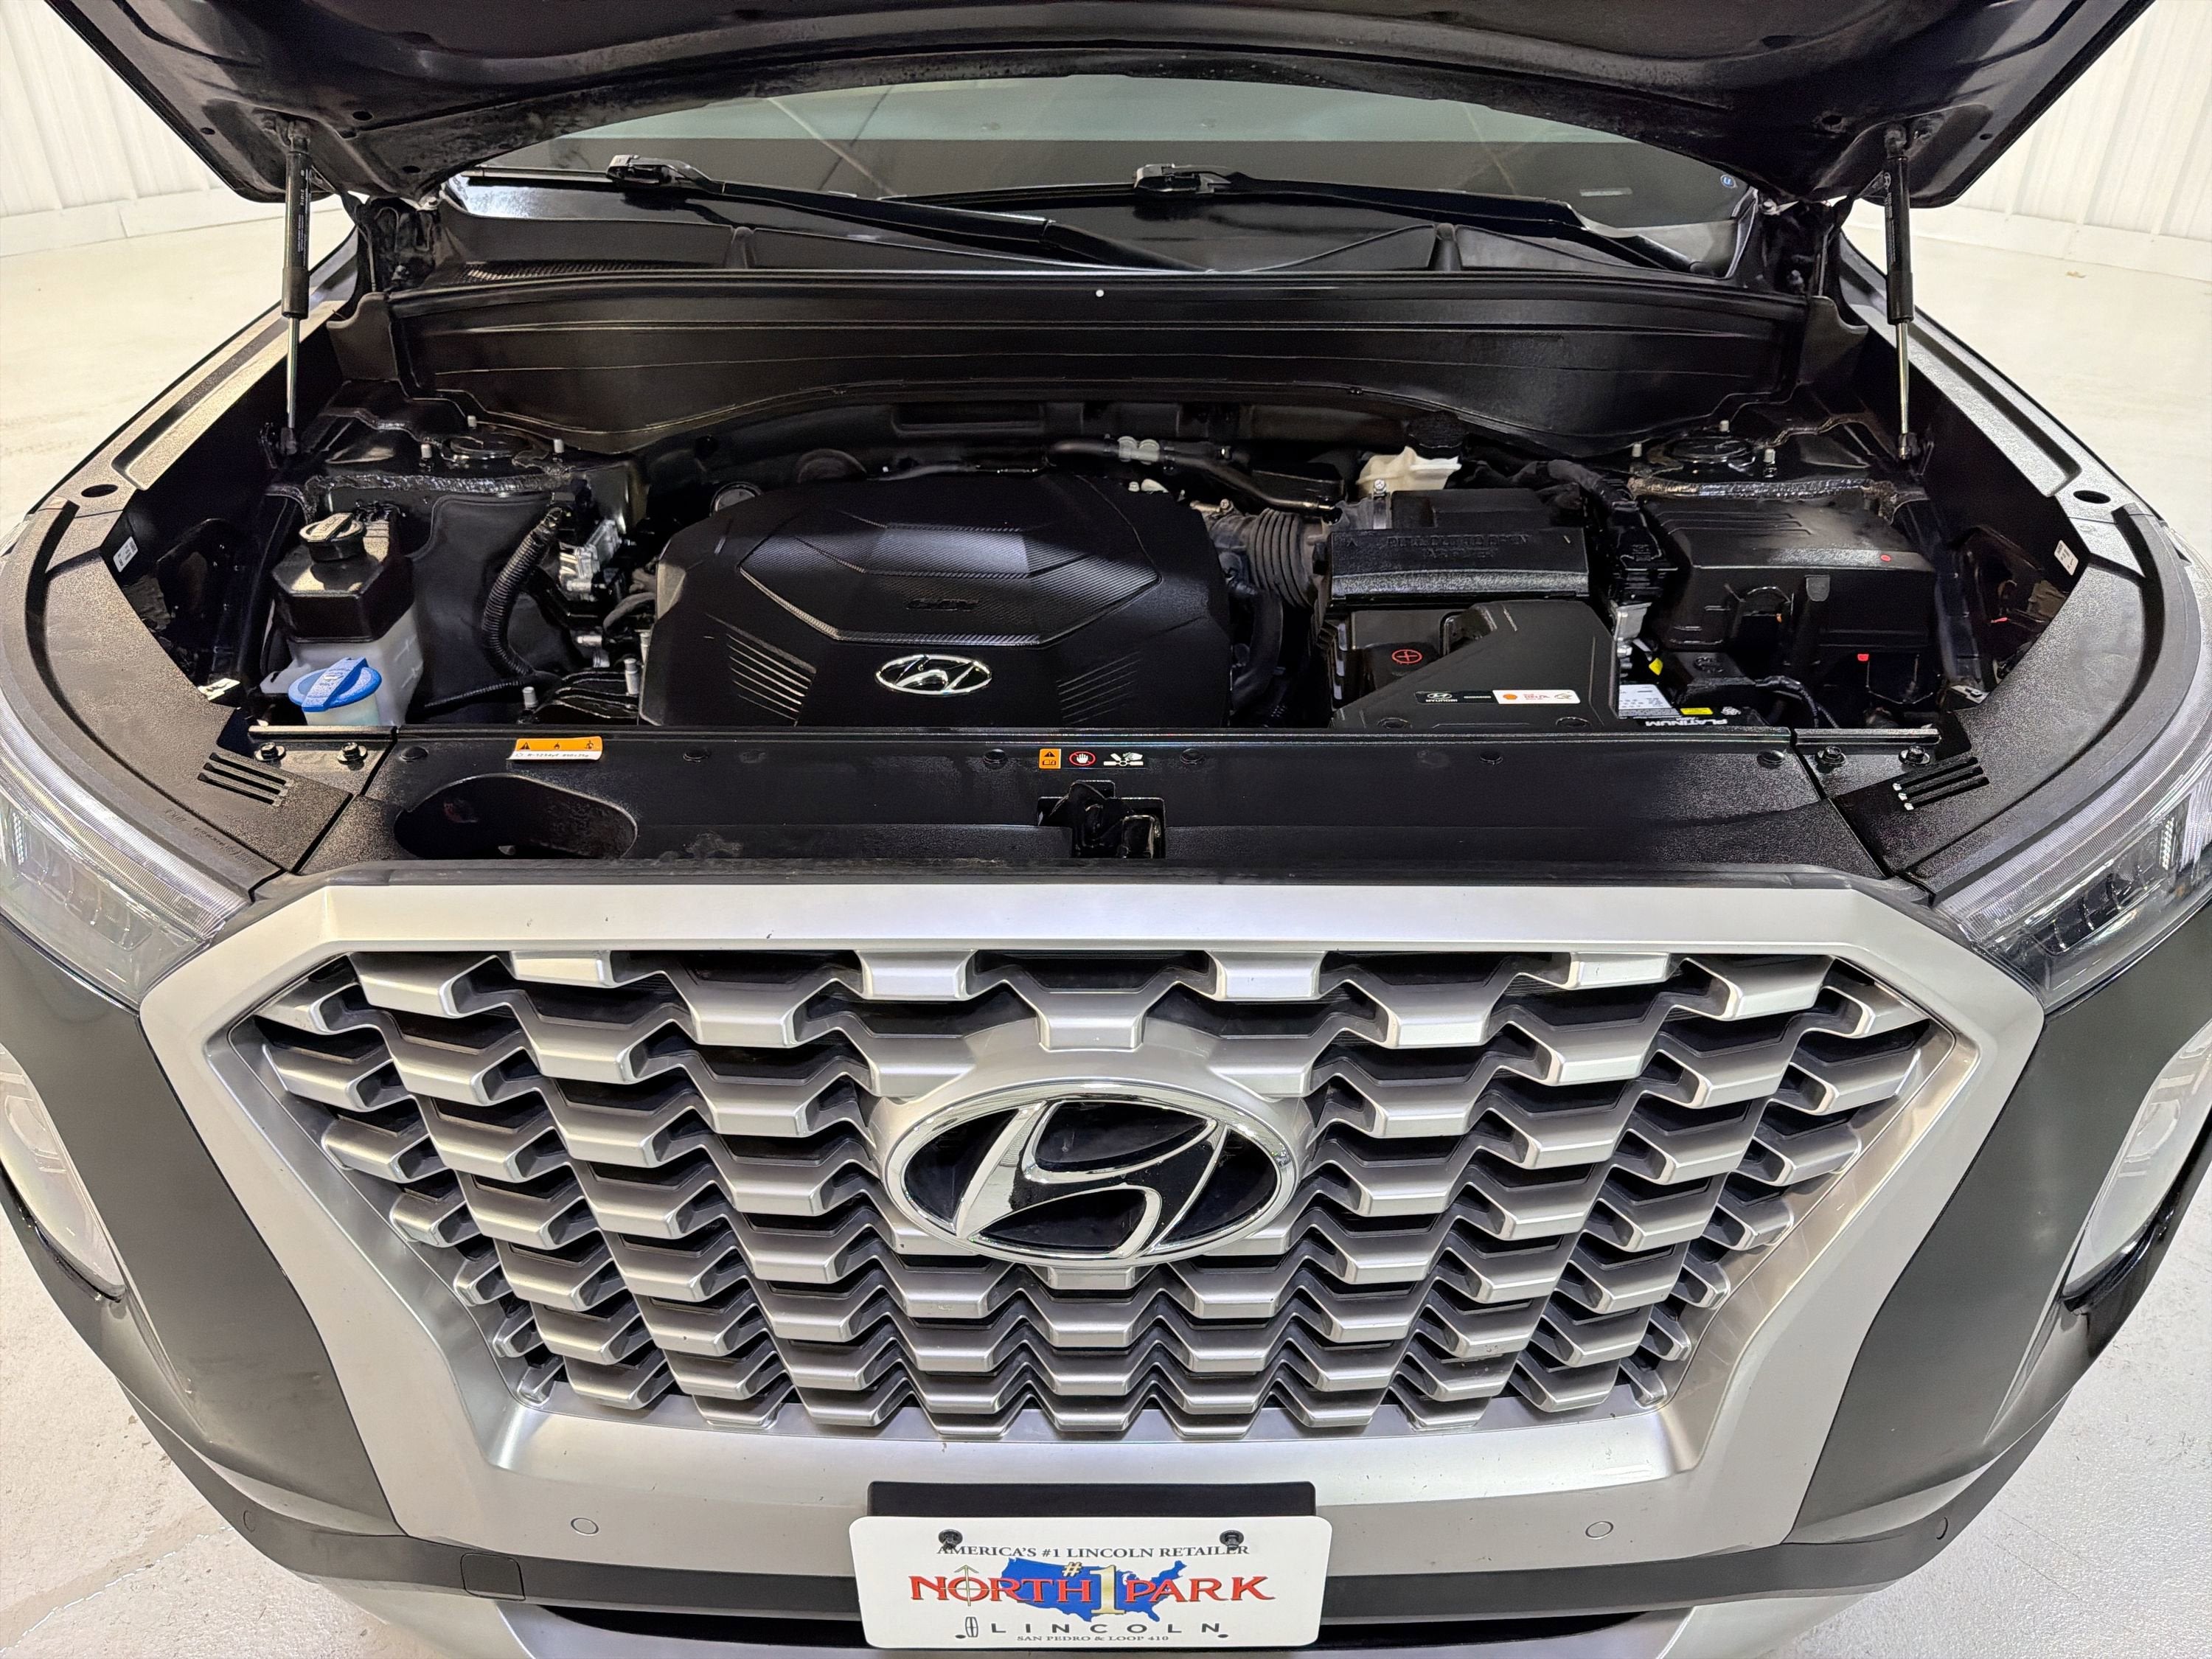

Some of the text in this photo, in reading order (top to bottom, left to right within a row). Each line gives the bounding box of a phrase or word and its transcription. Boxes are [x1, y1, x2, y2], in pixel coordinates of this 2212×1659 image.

[1645, 718, 1728, 727] PLATINUM
[936, 1545, 1251, 1558] AMERICA'S #1 LINCOLN RETAILER
[908, 1575, 1093, 1604] NORTH
[1124, 1576, 1276, 1603] PARK
[990, 1622, 1220, 1634] LINCOLN
